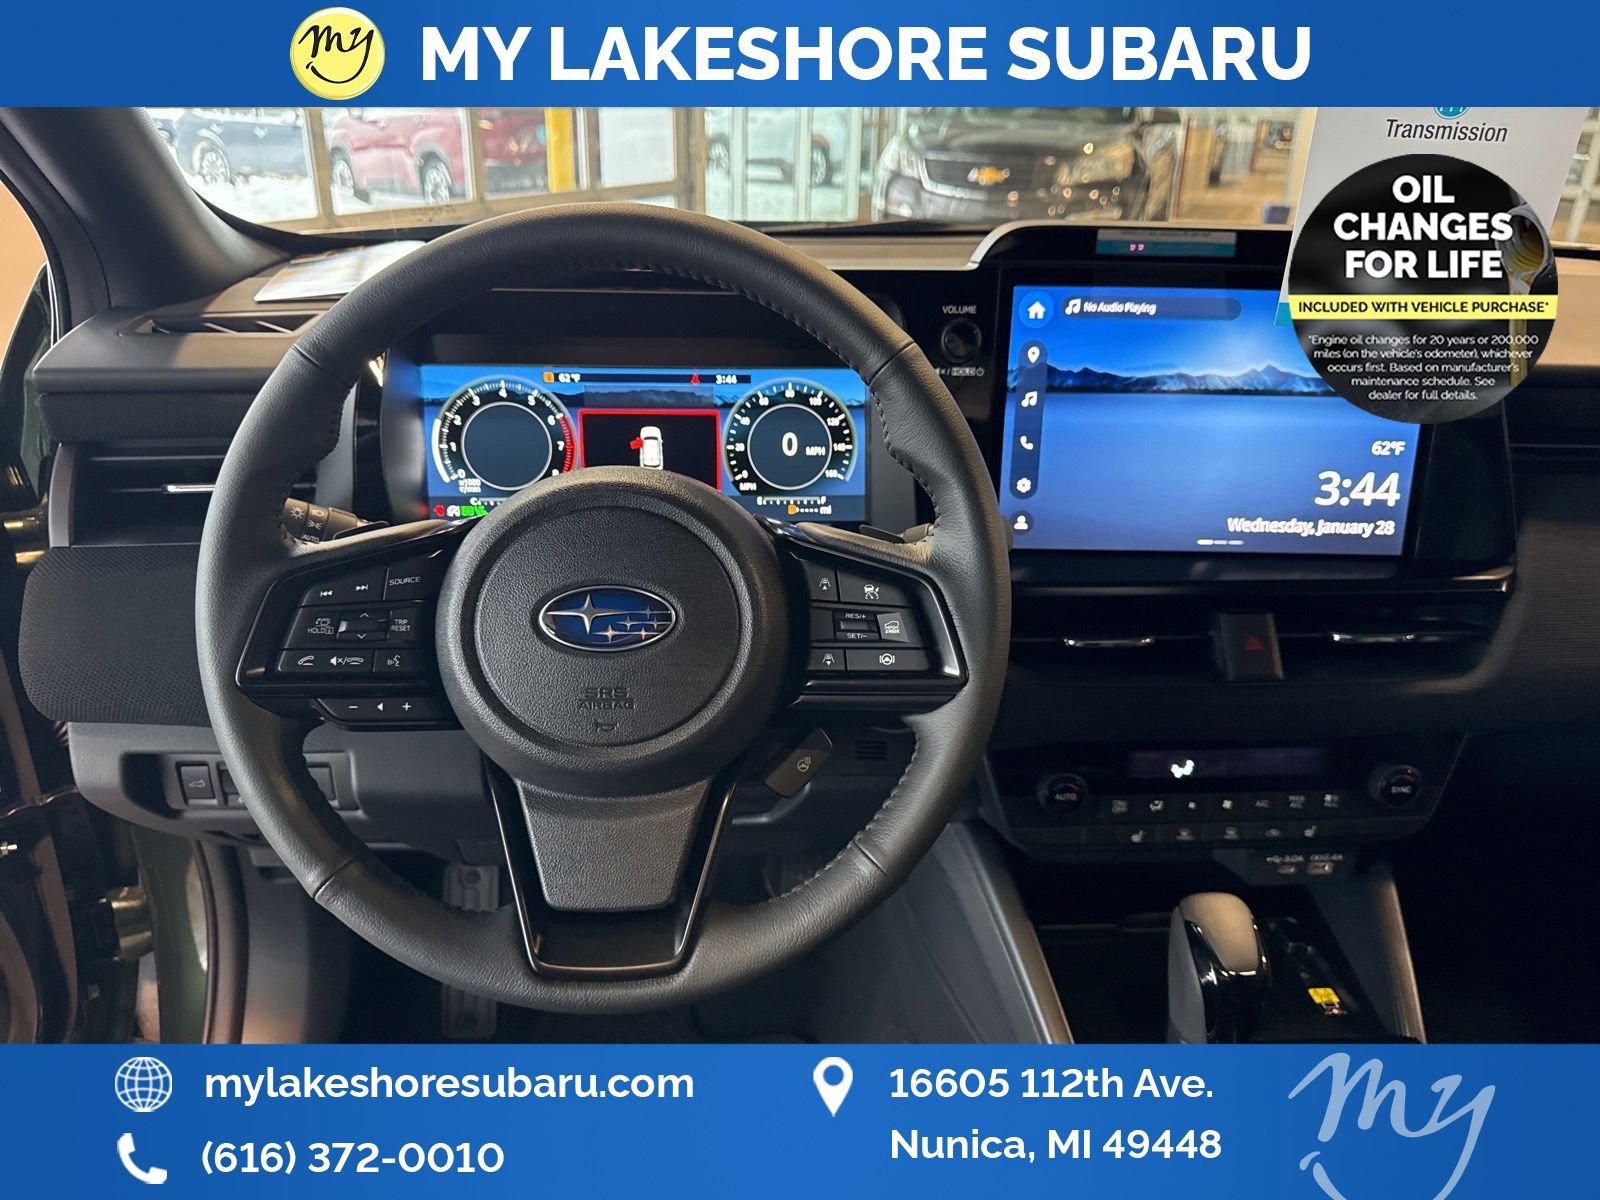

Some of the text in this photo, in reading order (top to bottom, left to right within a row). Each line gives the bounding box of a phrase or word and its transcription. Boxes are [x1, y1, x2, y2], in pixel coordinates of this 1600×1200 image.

[1386, 119, 1508, 143] Transmission
[942, 305, 977, 314] VOLUME
[1083, 302, 1157, 315] No Audio Playing
[715, 374, 738, 385] 3:44
[499, 388, 507, 398] 4
[472, 395, 481, 406] 3
[527, 395, 536, 406] 5
[809, 396, 822, 406] 100
[453, 415, 462, 426] 2
[547, 415, 556, 426] 6
[827, 416, 839, 426] 120
[735, 443, 745, 452] 20
[782, 432, 826, 457] 0 MPH
[833, 443, 846, 452] 140
[1371, 440, 1406, 456] 62°F
[741, 470, 748, 479] 0
[739, 482, 757, 491] MPH
[1314, 470, 1401, 507] 3:44
[1226, 517, 1396, 539] Wednesday, January 28
[389, 576, 421, 586] SOURCE
[391, 624, 411, 632] RESET
[585, 688, 630, 699] SRS
[579, 701, 637, 710] AIRBAG
[1391, 785, 1413, 794] SYNC
[1054, 792, 1079, 801] AUTO
